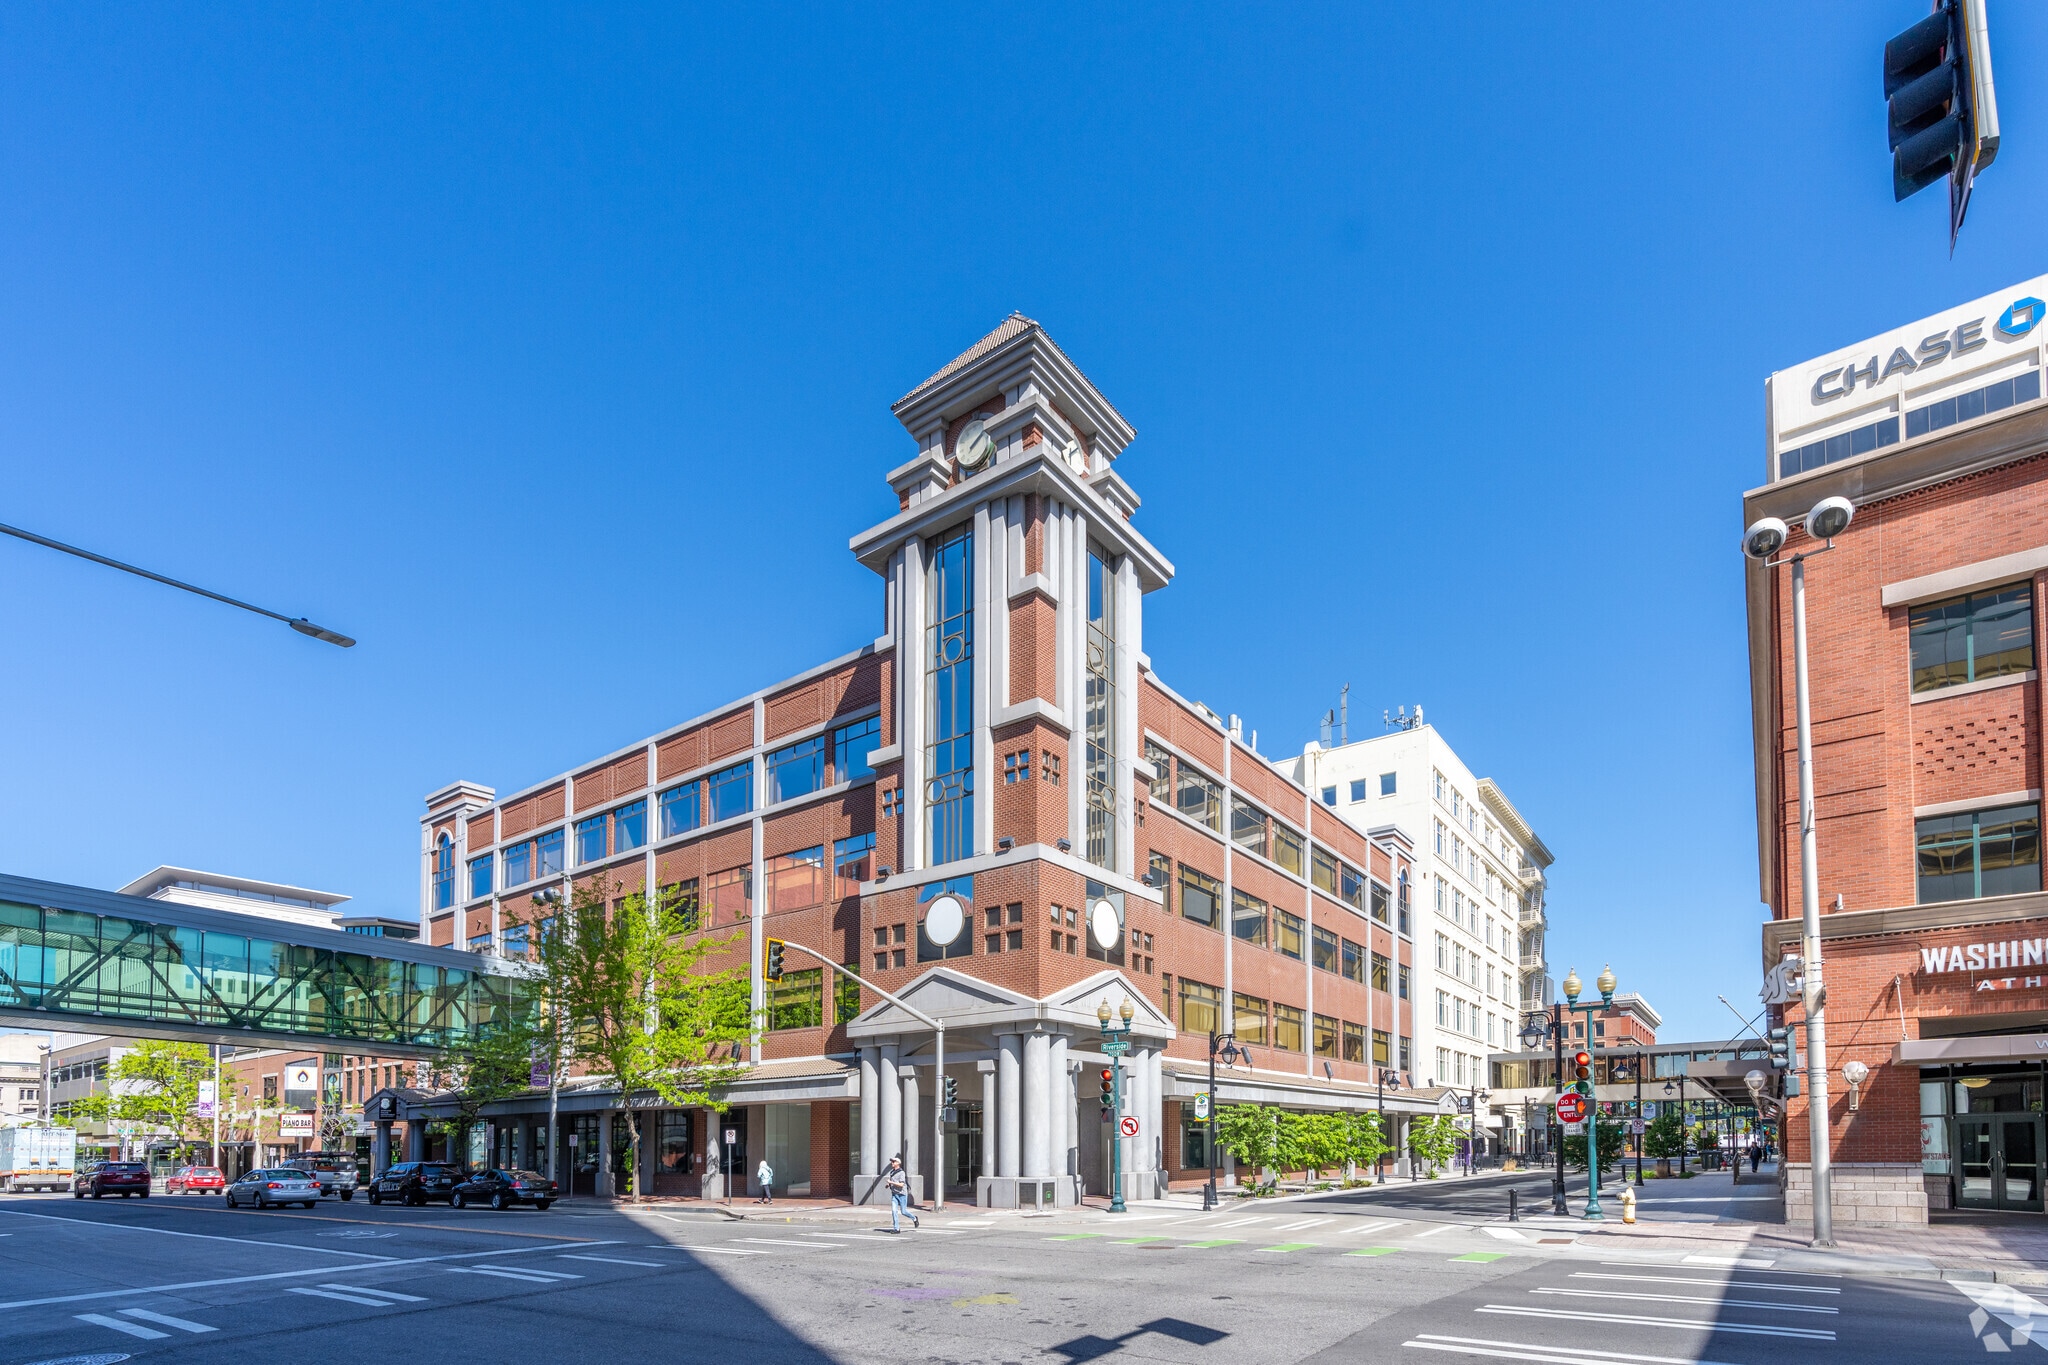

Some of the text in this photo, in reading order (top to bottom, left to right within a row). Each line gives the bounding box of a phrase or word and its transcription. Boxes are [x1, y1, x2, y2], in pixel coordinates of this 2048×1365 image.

[1814, 316, 1987, 399] CHASE
[1920, 937, 2048, 974] WASHIN
[1977, 976, 2041, 991] ATH
[1103, 1042, 1127, 1051] Riverside
